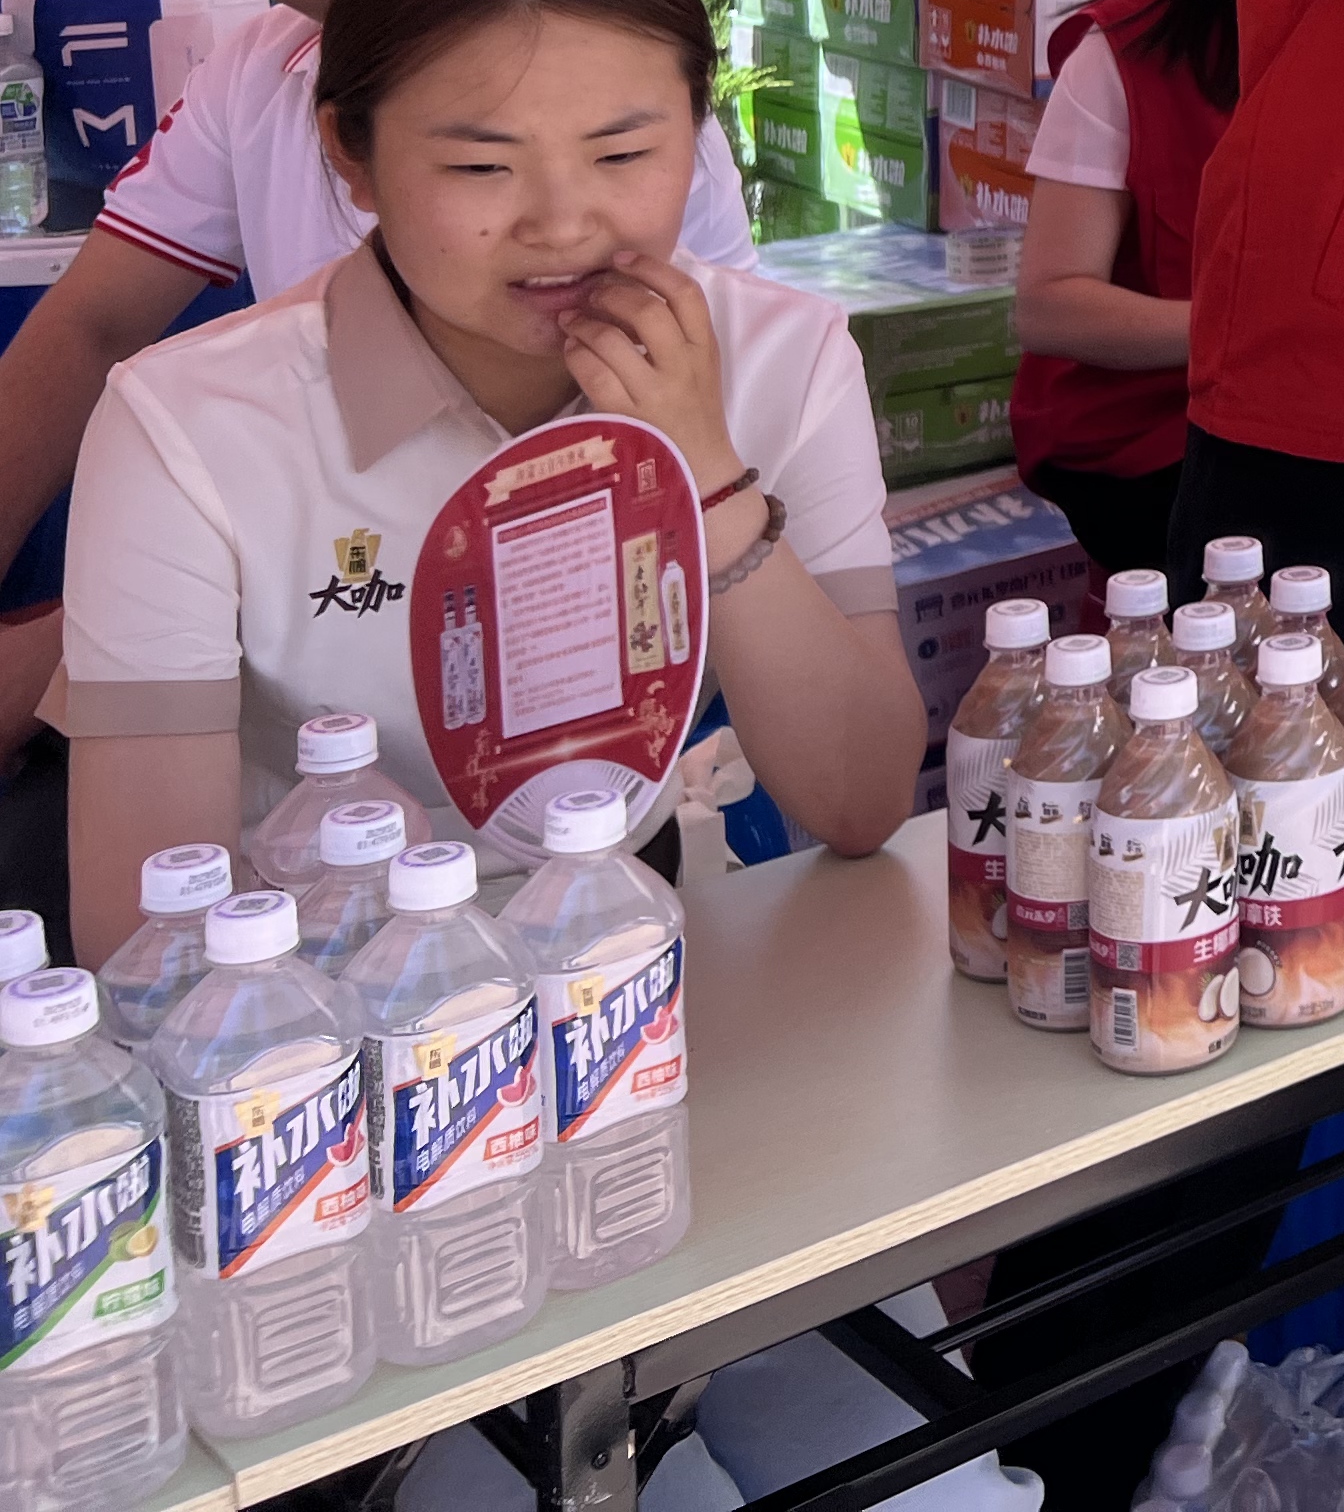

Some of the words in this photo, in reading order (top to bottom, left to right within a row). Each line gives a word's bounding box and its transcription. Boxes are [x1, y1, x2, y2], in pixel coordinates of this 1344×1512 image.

[308, 569, 406, 618] 大咖
[1239, 902, 1284, 928] 拿铁
[408, 1006, 533, 1150] 补水啦
[565, 950, 674, 1082] 补水啦
[232, 1060, 361, 1214] 补水啦
[5, 1152, 151, 1307] 补水啦
